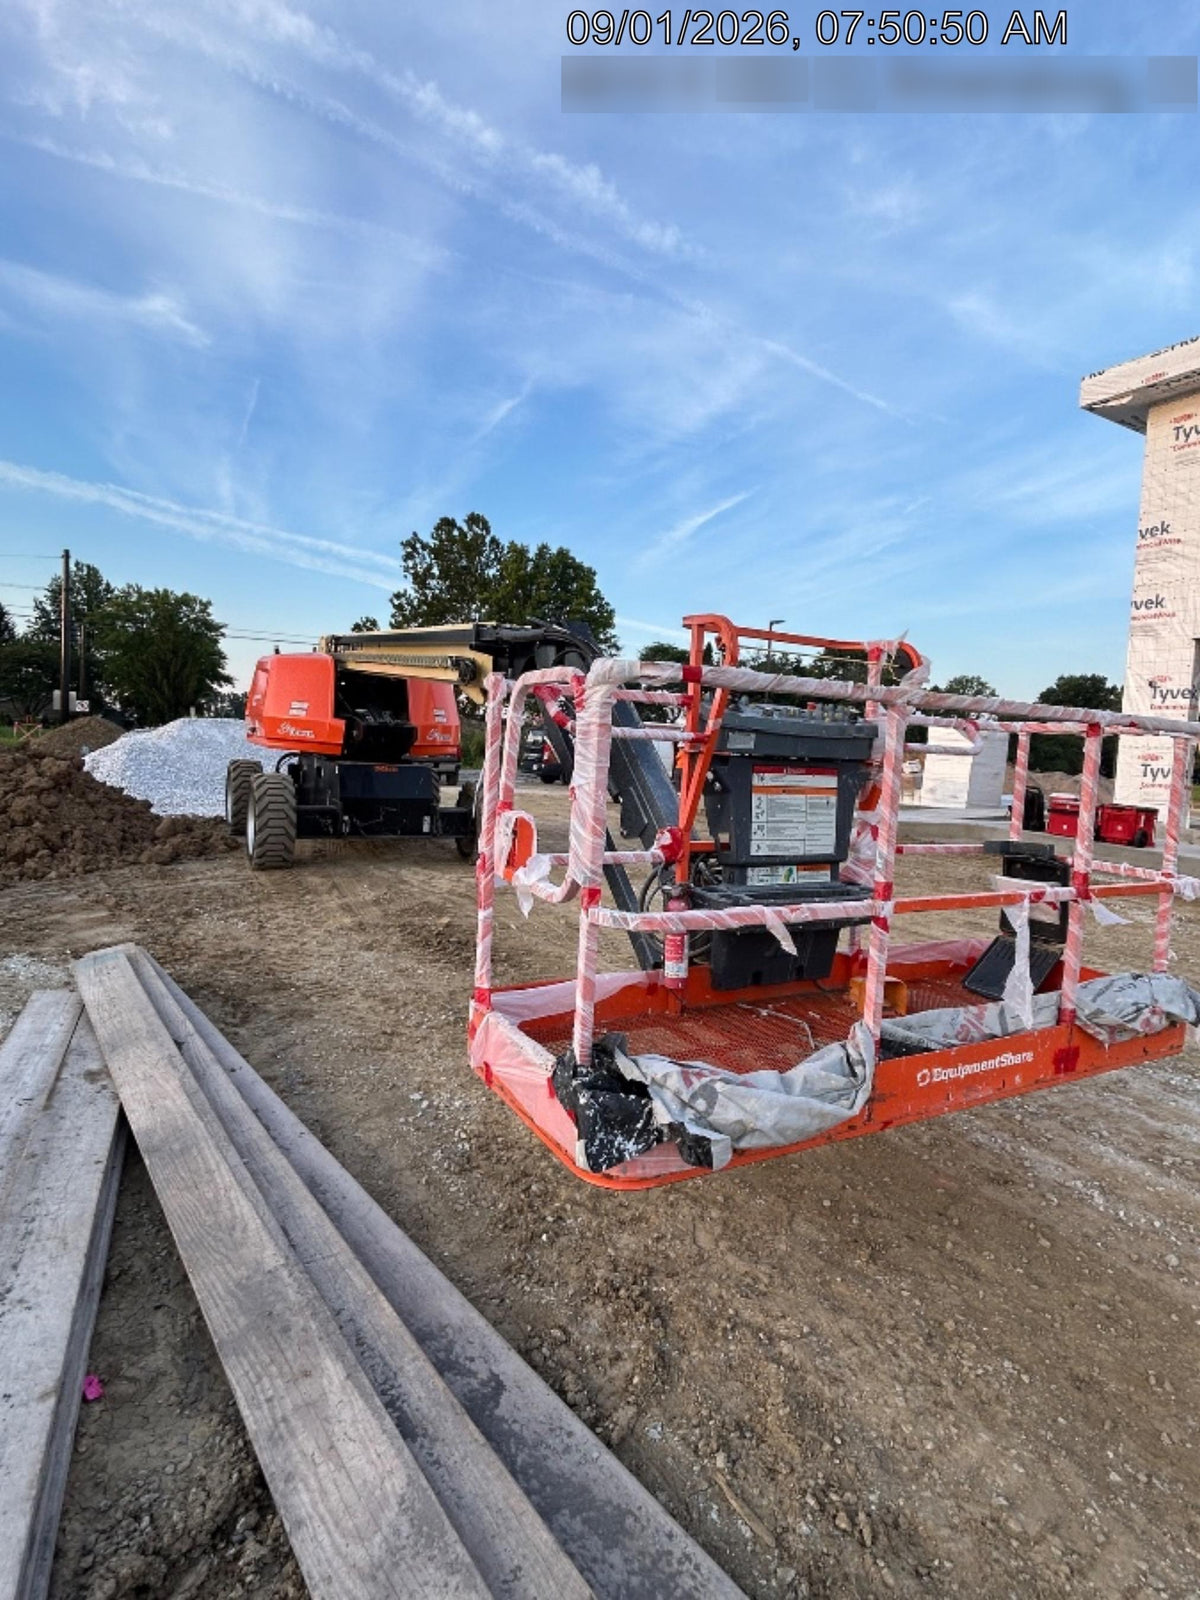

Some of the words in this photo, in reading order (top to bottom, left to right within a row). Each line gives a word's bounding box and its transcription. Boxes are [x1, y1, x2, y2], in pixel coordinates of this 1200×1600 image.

[1131, 593, 1165, 611] vek
[1151, 684, 1199, 704] Tyvek
[1141, 764, 1188, 782] Tyv
[932, 1051, 1034, 1082] EquipmentShare
